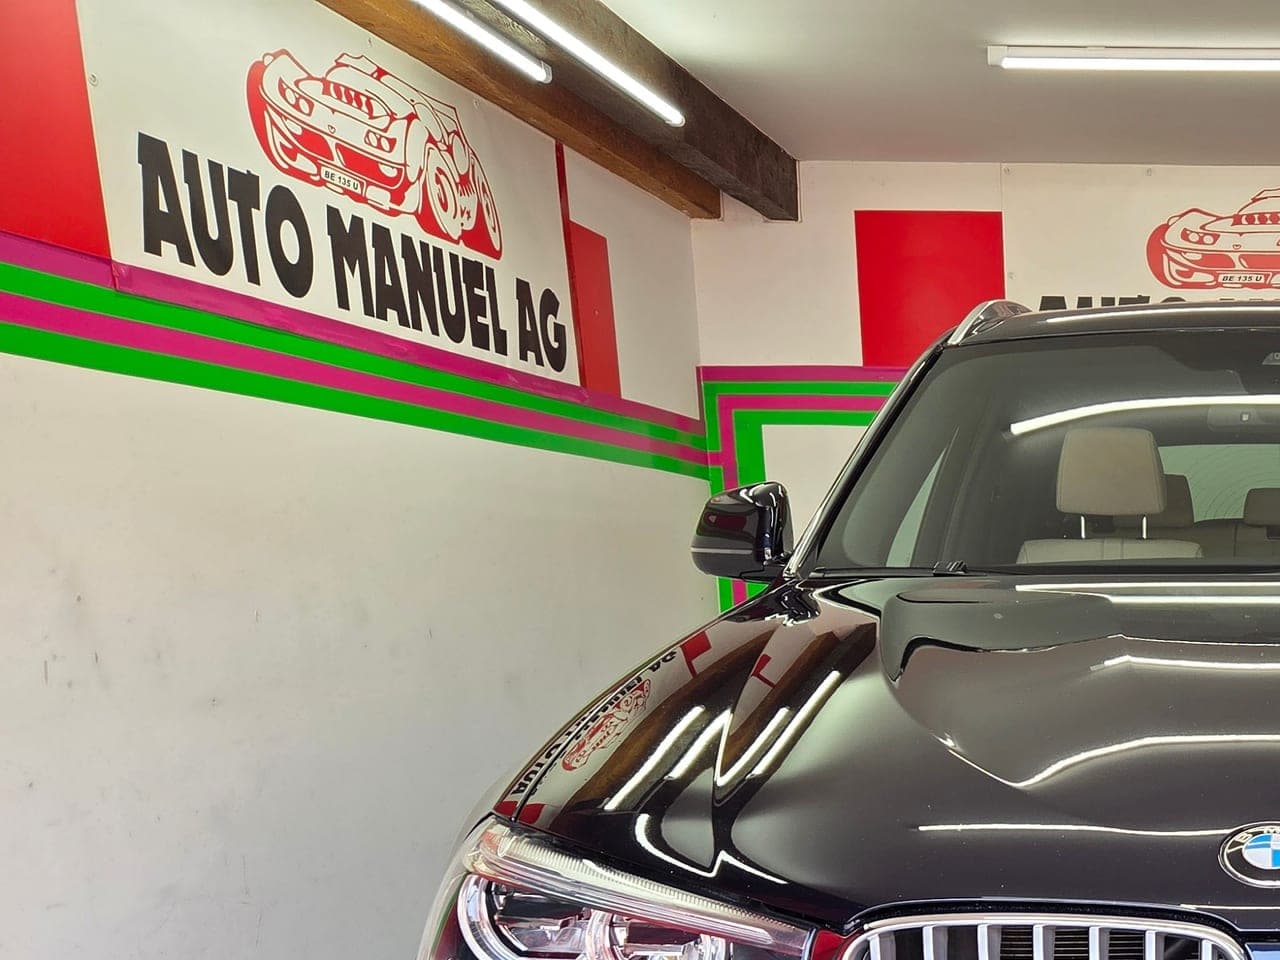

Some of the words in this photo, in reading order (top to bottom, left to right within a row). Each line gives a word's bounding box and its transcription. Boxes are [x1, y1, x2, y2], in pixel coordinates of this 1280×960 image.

[324, 170, 336, 182] BE
[338, 176, 351, 188] 135
[352, 182, 359, 191] U
[137, 131, 315, 299] AUTO
[326, 204, 508, 357] MANUEL
[515, 277, 568, 373] AG
